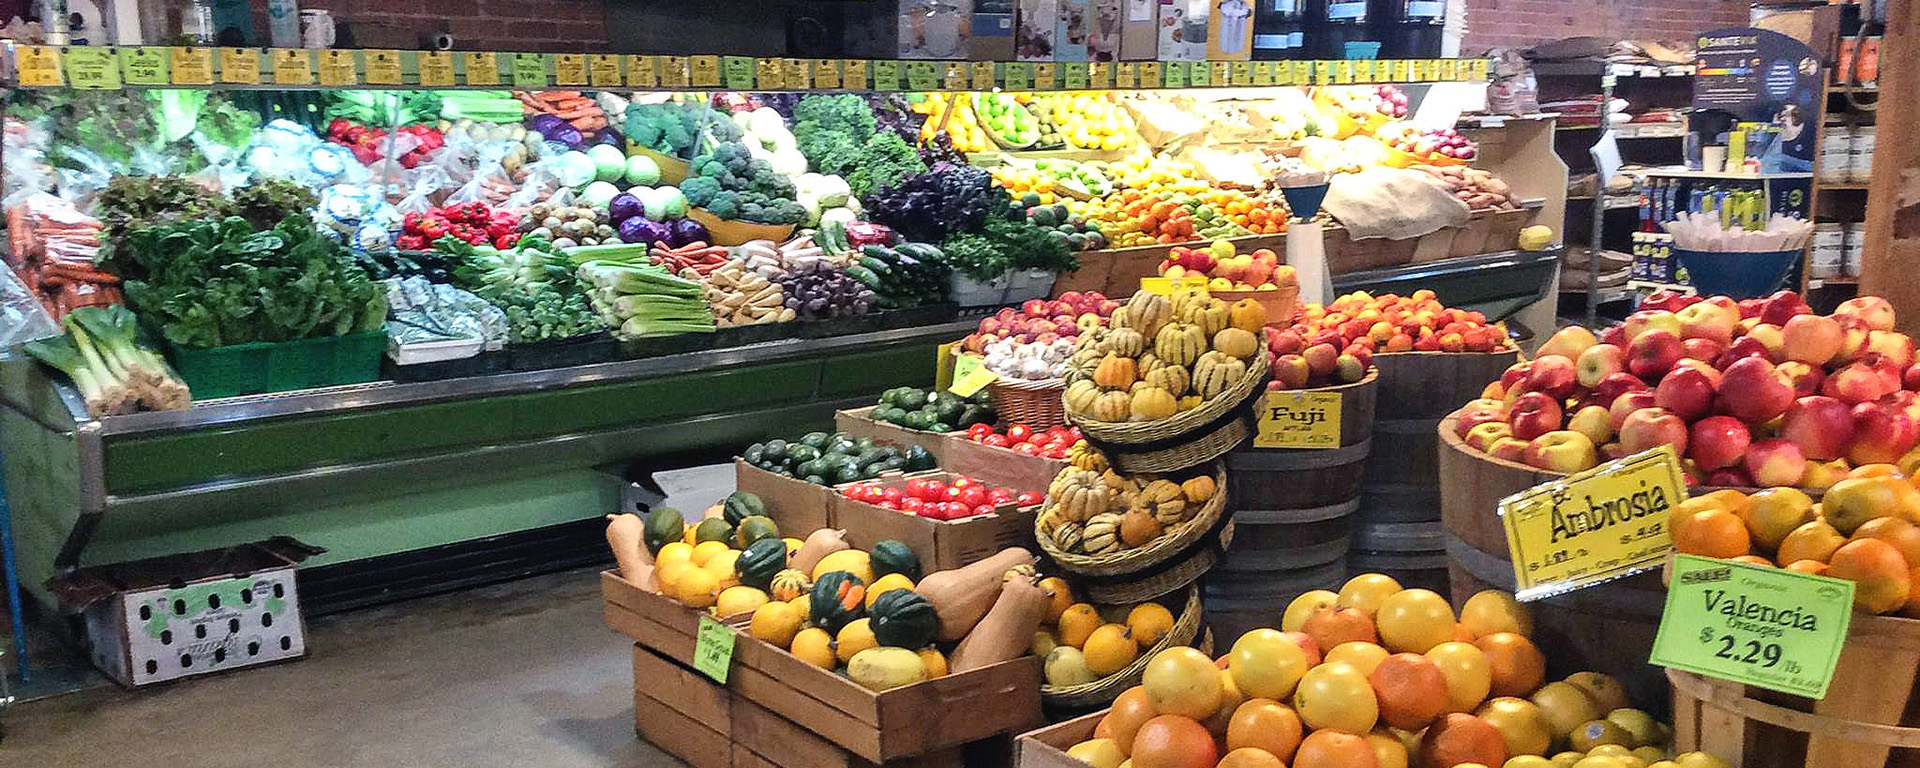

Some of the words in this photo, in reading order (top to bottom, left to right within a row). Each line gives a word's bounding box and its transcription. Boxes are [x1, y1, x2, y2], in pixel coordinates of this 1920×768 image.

[1270, 406, 1326, 425] Fuji
[1550, 480, 1669, 544] Ambrosia
[1703, 589, 1818, 632] Valencia
[1726, 617, 1783, 639] Oranges
[1699, 626, 1715, 643] $
[1715, 634, 1783, 668] 2.29
